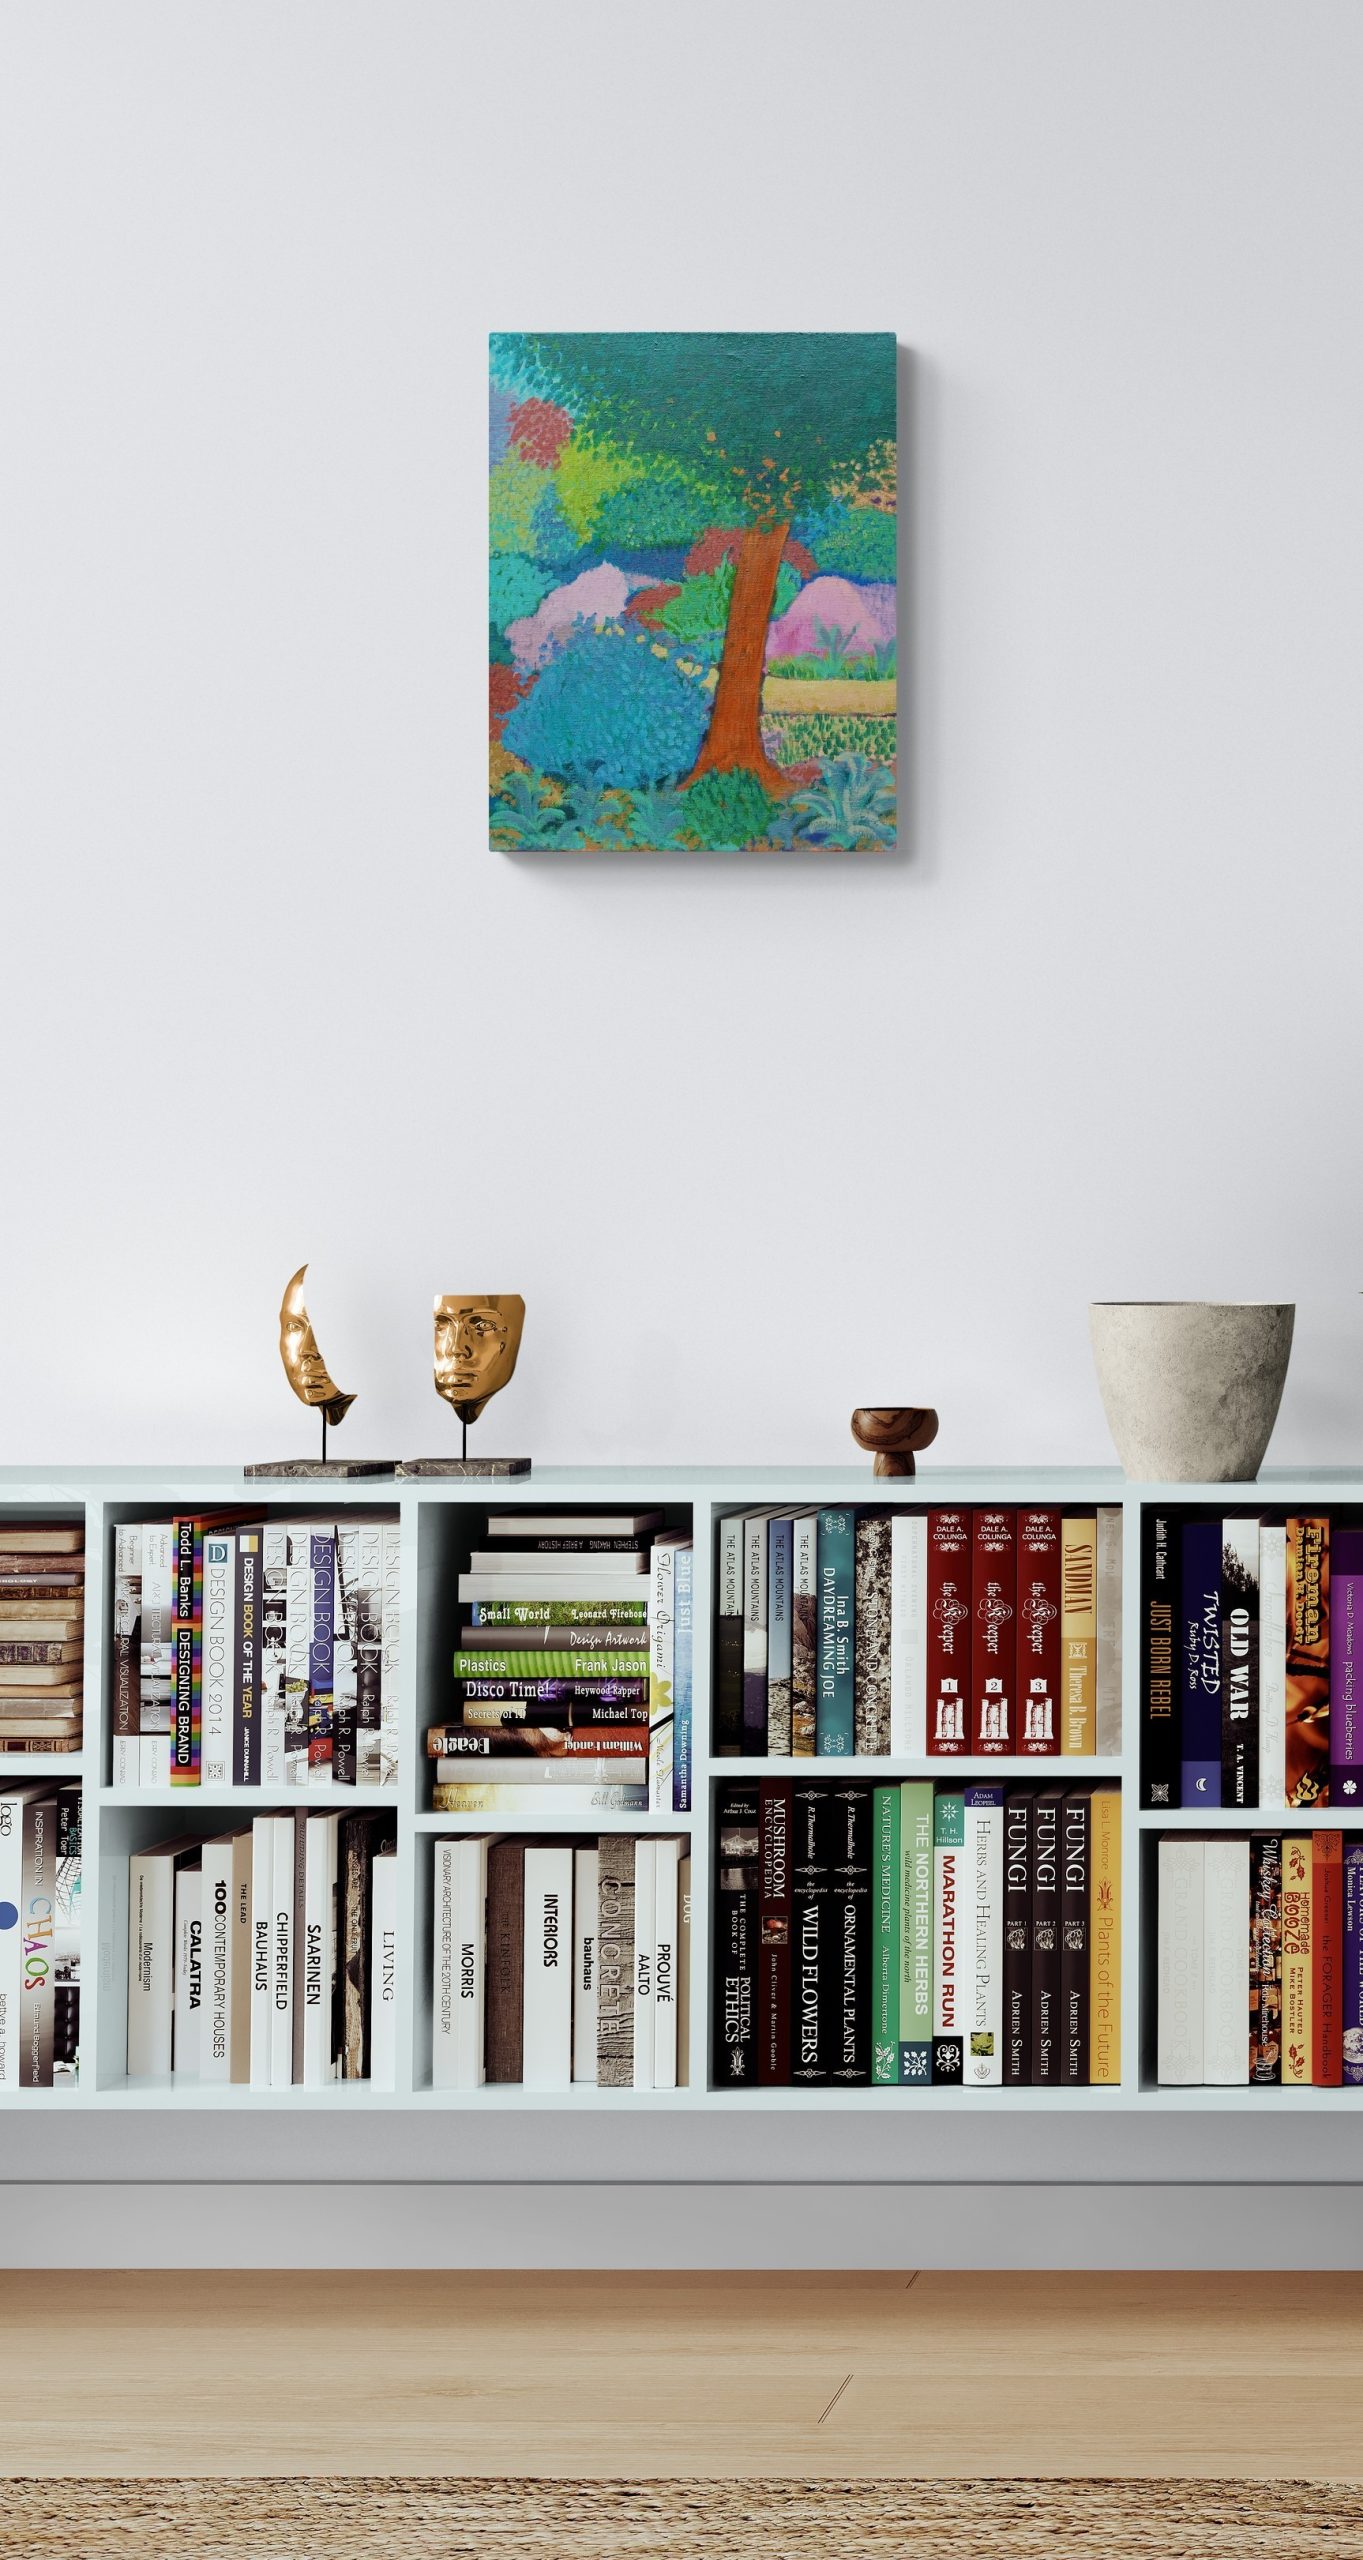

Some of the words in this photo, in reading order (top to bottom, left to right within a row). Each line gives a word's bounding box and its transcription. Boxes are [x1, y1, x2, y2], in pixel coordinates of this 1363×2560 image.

[180, 1523, 192, 1555] Todd
[751, 1534, 760, 1548] THE
[776, 1534, 784, 1548] THE
[1156, 1519, 1167, 1540] Judith
[1156, 1542, 1167, 1550] H.
[180, 1560, 191, 1571] L.
[243, 1558, 254, 1602] DESIGN
[313, 1532, 332, 1604] DESIGN
[361, 1532, 380, 1604] DESIGN
[677, 1555, 692, 1593] Blue
[751, 1552, 760, 1576] ATLAS
[776, 1552, 784, 1576] ATLAS
[1064, 1544, 1092, 1614] SANDMAN
[1156, 1552, 1168, 1580] Cathcart
[179, 1577, 192, 1617] Banks
[209, 1568, 226, 1630] DESIGN
[750, 1578, 760, 1622] MOUNTAINS
[775, 1578, 784, 1622] MOUNTAINS
[837, 1596, 849, 1616] Ina
[1306, 1527, 1322, 1644] Fireman
[243, 1604, 254, 1638] BOOK
[480, 1608, 510, 1622] Small
[514, 1608, 550, 1622] World
[678, 1598, 692, 1635] Just
[823, 1567, 836, 1671] DAYDREAMING
[836, 1620, 849, 1632] B.
[1150, 1601, 1172, 1632] JUST
[1184, 1621, 1200, 1650] Ruby
[1230, 1608, 1250, 1656] OLD
[209, 1636, 225, 1688] BOOK
[243, 1641, 253, 1658] OF
[312, 1612, 331, 1674] BOOK
[360, 1612, 379, 1674] BOOK
[836, 1636, 850, 1674] Smith
[1150, 1638, 1172, 1674] BORN
[1188, 1654, 1200, 1666] D.
[1201, 1591, 1220, 1694] TWISTED
[178, 1631, 191, 1711] DESIGNING
[242, 1662, 253, 1684] THE
[460, 1658, 506, 1672] Plastics
[576, 1658, 608, 1672] Frank
[612, 1658, 647, 1672] Jason
[1188, 1668, 1198, 1690] Ross
[1342, 1662, 1356, 1700] packing
[242, 1686, 253, 1718] YEAR
[466, 1682, 504, 1698] Disco
[510, 1682, 550, 1698] Time!
[820, 1675, 834, 1698] JOE
[946, 1682, 952, 1690] 1
[990, 1682, 998, 1690] 2
[1035, 1682, 1042, 1690] 3
[1150, 1680, 1172, 1720] REBEL
[1230, 1664, 1249, 1720] WAR
[209, 1694, 222, 1735] 2014
[592, 1709, 628, 1718] Michael
[631, 1709, 648, 1721] Top
[1345, 1704, 1356, 1760] blueberries
[177, 1716, 190, 1764] BRAND
[432, 1737, 490, 1754] Beagle
[680, 1720, 690, 1761] Downing
[1236, 1744, 1244, 1752] T.
[1236, 1754, 1244, 1763] A.
[679, 1764, 688, 1809] Samantha
[1236, 1766, 1244, 1804] VINCENT
[0, 1802, 18, 1836] logo
[60, 1808, 70, 1832] Peter
[882, 1796, 892, 1862] NATURE'S
[916, 1814, 928, 1848] THE
[34, 1812, 44, 1874] INSPIRATION
[60, 1837, 69, 1856] Toer
[69, 1827, 77, 1856] BASICS
[764, 1799, 772, 1898] ENCYCLOPEDIA
[773, 1798, 786, 1898] MUSHROOM
[904, 1850, 912, 1866] wild
[936, 1836, 962, 1844] Hillson
[977, 1820, 990, 1866] HERBS
[1008, 1808, 1026, 1892] FUNGI
[1037, 1808, 1056, 1892] FUNGI
[1066, 1808, 1084, 1892] FUNGI
[34, 1876, 44, 1887] IN
[904, 1868, 912, 1906] medicine
[977, 1870, 986, 1900] AND
[1258, 1839, 1278, 1902] Whiskey
[1347, 1866, 1356, 1898] Monica
[882, 1866, 892, 1933] MEDICINE
[916, 1853, 928, 1950] NORTHERN
[942, 1856, 955, 1976] MARATHON
[1347, 1900, 1356, 1932] Lewson
[544, 1894, 558, 1968] INTERIORS
[802, 1905, 818, 1960] WILD
[902, 1908, 912, 1934] plants
[902, 1936, 912, 1945] of
[976, 1906, 990, 1970] HEALING
[1262, 1904, 1278, 1976] Collection
[1300, 1892, 1310, 1954] Homemade
[24, 1897, 52, 1990] CHAOS
[256, 1922, 268, 1991] BAUHAUS
[276, 1912, 288, 2010] CHIPPERFIELD
[600, 1875, 622, 2032] CONCRETE
[732, 1942, 738, 1954] OF
[844, 1904, 856, 2006] ORNAMENTAL
[904, 1946, 912, 1958] the
[1098, 1918, 1114, 1966] Plants
[143, 1942, 152, 1992] Modernism
[190, 1920, 202, 2010] CALATRA
[306, 1924, 322, 2005] SAARINEN
[382, 1931, 394, 2002] LIVING
[461, 1944, 474, 1998] MORRIS
[584, 1937, 594, 1991] bauhaus
[638, 1954, 650, 1996] AALTO
[657, 1944, 674, 2002] PROUVÉ
[882, 1946, 890, 1981] Alberta
[904, 1960, 912, 1982] north
[1098, 1970, 1114, 1988] of
[915, 1956, 928, 2015] HERBS
[942, 1984, 954, 2027] RUN
[976, 1974, 990, 2026] PLANTS
[1098, 1992, 1114, 2018] the
[726, 1977, 740, 2043] ETHICS
[740, 1977, 750, 2042] POLITICAL
[802, 1965, 818, 2063] FLOWERS
[1012, 1990, 1022, 2034] ADRIEN
[1040, 1990, 1051, 2034] ADRIEN
[1069, 1990, 1080, 2034] ADRIEN
[844, 2008, 856, 2063] PLANTS
[1098, 2024, 1112, 2078] Future
[1012, 2040, 1022, 2076] SMITH
[1040, 2040, 1051, 2076] SMITH
[1069, 2040, 1080, 2076] SMITH
